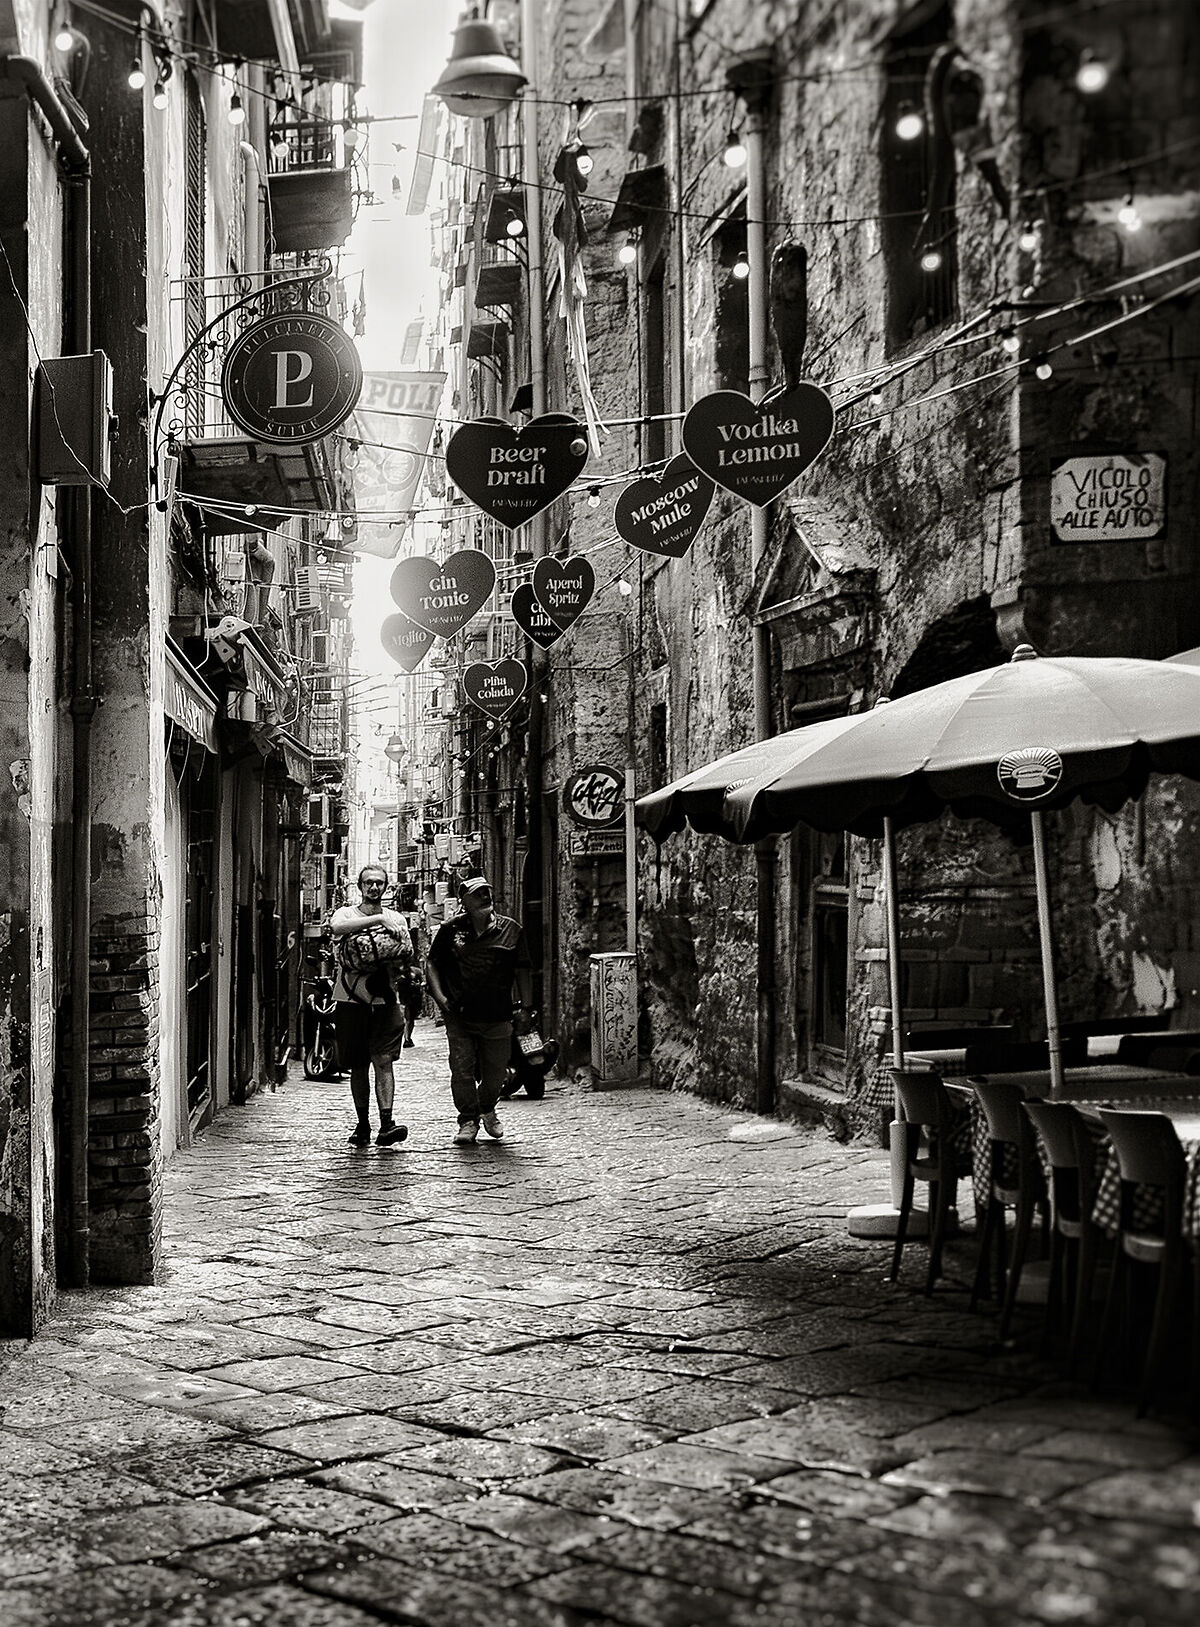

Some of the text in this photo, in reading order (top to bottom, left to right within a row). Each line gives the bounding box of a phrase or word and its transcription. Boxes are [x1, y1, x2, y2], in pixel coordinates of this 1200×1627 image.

[243, 321, 344, 355] PULCINELLA
[366, 379, 439, 411] POLI
[264, 419, 320, 436] SUITE
[717, 414, 800, 442] Vodka
[490, 446, 547, 464] Beer
[718, 442, 801, 467] Lemon
[487, 463, 546, 487] Draft
[1065, 468, 1151, 492] VICOLO
[630, 475, 700, 526] Moscow
[1075, 487, 1148, 510] CHIUSO
[650, 502, 692, 535] Mule
[1059, 506, 1154, 529] ALLE AUTO
[429, 575, 457, 592] Gin
[545, 575, 584, 593] Aperol
[419, 591, 470, 610] Tonic
[548, 591, 580, 608] Spritz
[391, 630, 427, 648] Mojito
[477, 685, 515, 700] Colada
[483, 675, 507, 687] Piña
